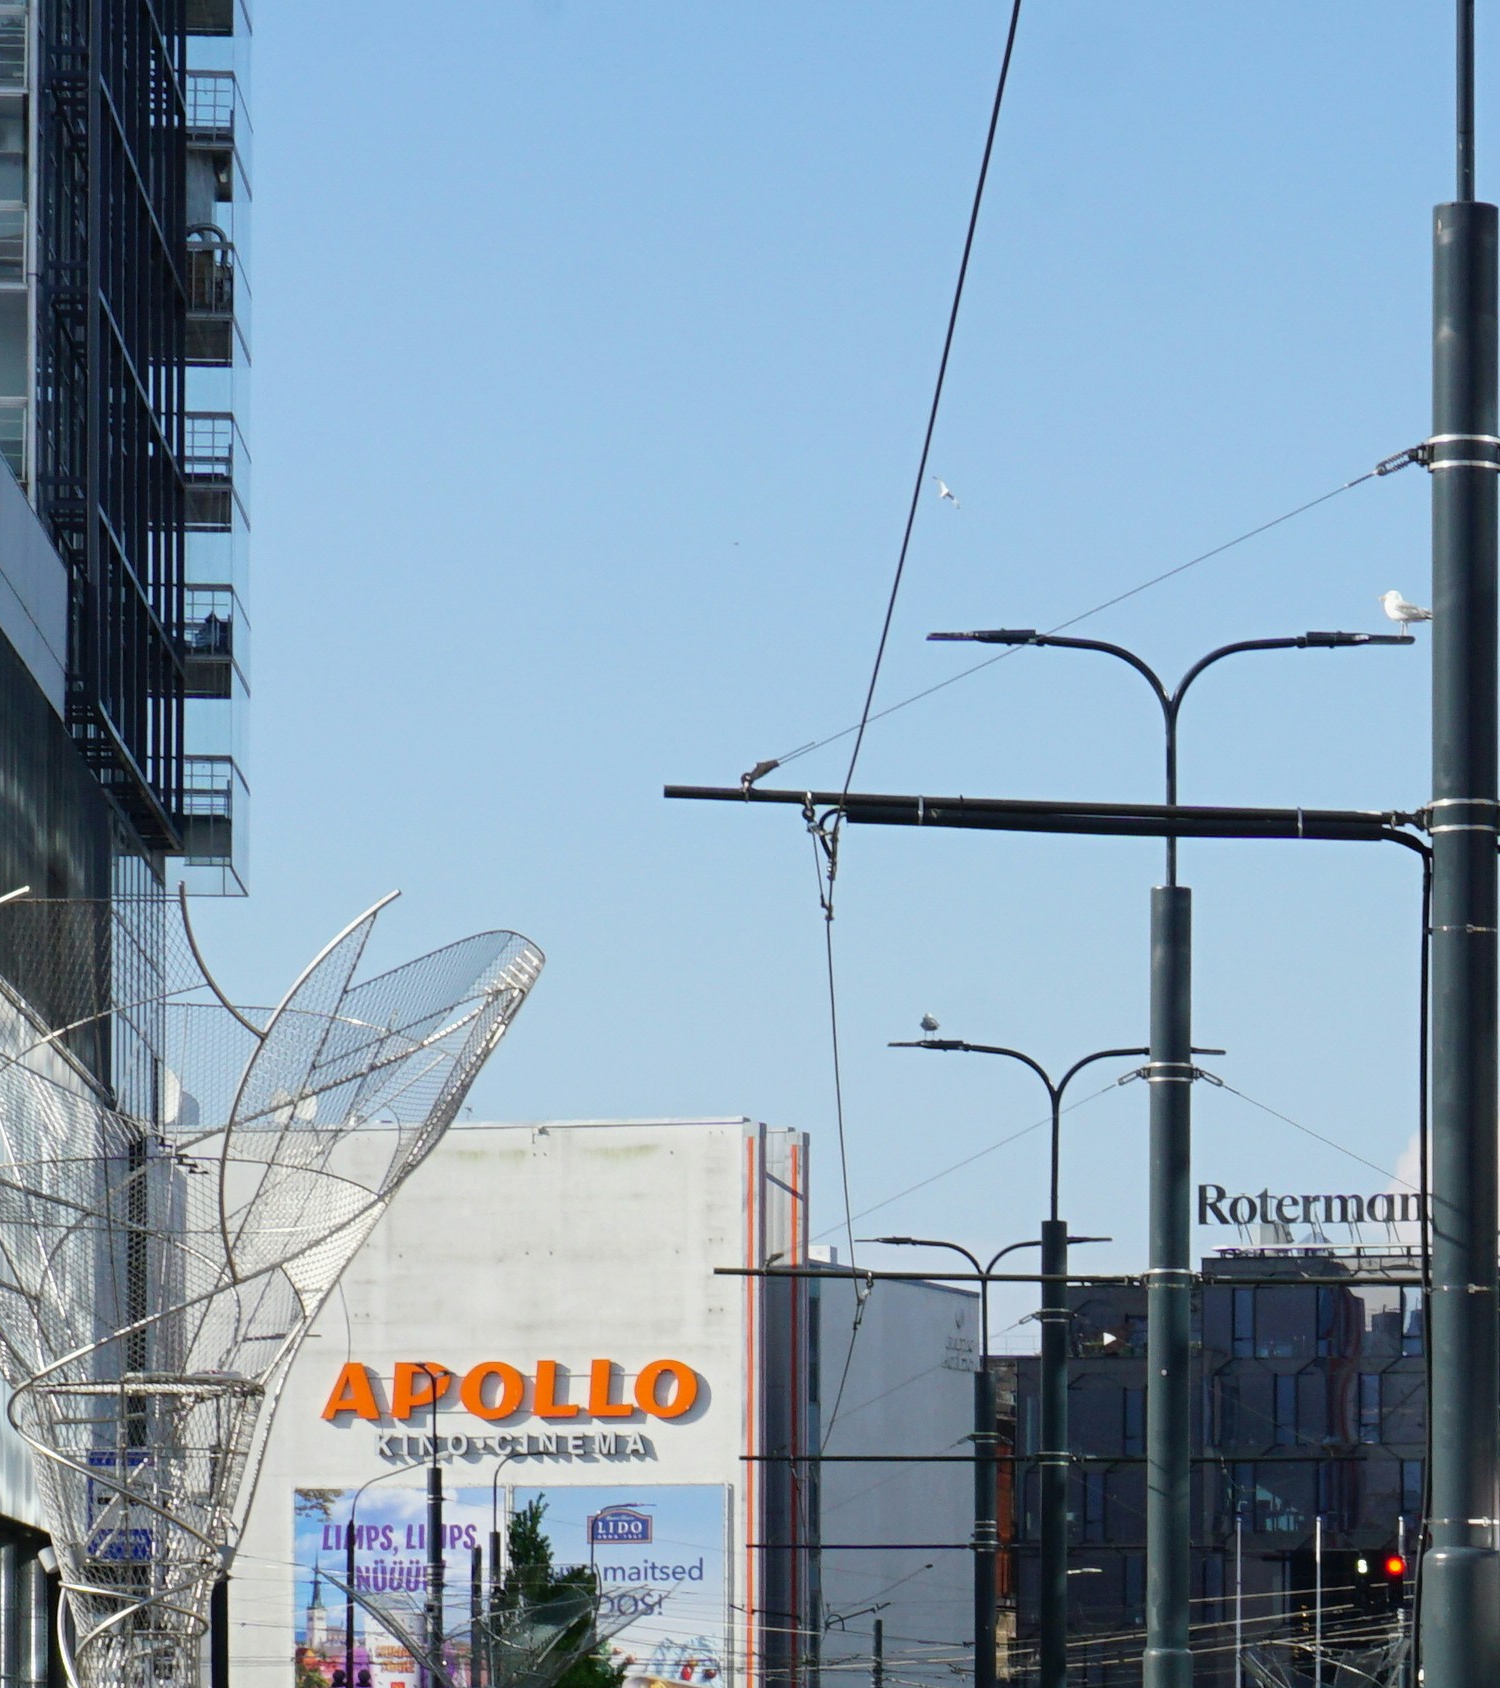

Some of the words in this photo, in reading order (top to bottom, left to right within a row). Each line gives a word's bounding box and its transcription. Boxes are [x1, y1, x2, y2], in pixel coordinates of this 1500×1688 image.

[1198, 1184, 1432, 1224] Roterman
[320, 1359, 698, 1420] APOLLO
[597, 1521, 643, 1534] LIDO
[355, 1559, 446, 1592] NÜÜÜ
[604, 1557, 704, 1581] maitsed
